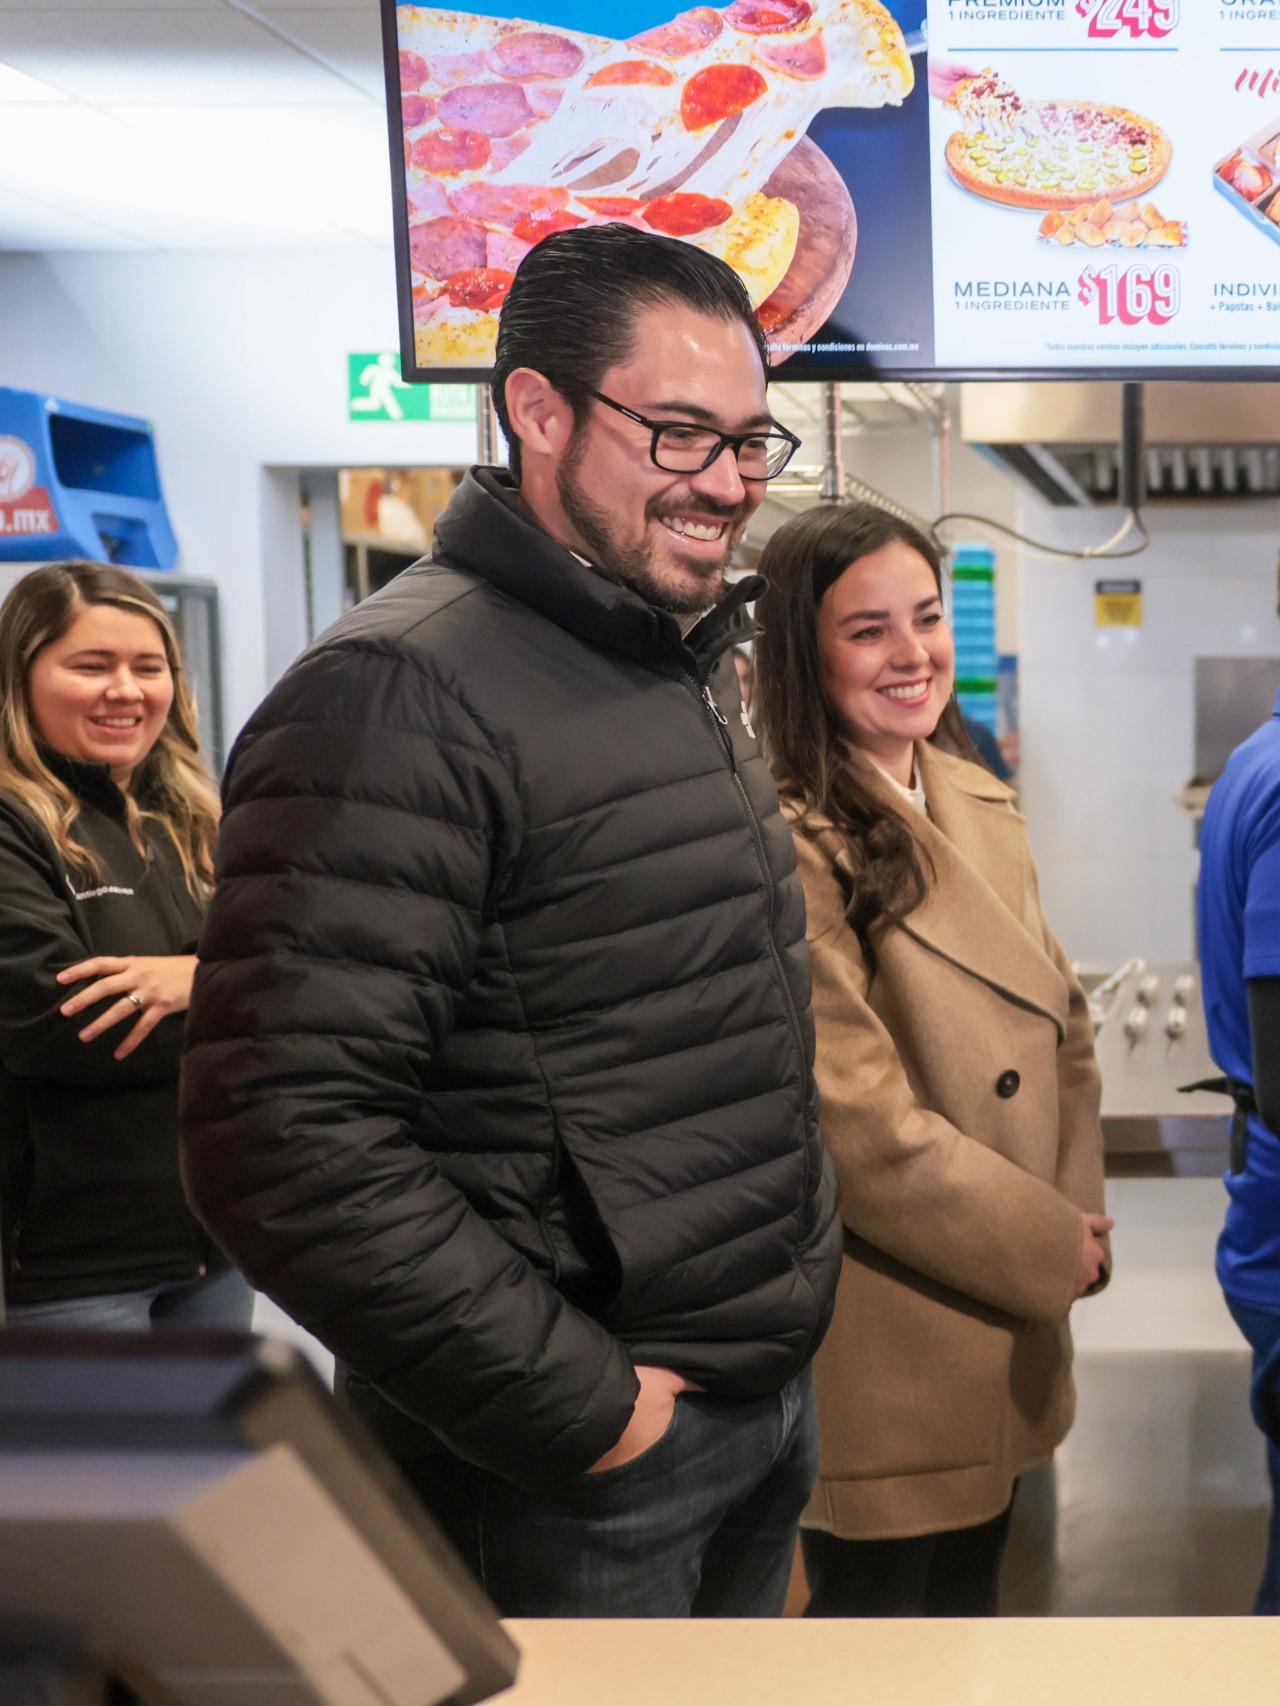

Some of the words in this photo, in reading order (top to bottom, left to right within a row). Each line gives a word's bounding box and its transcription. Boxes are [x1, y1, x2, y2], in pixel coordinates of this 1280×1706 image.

[949, 10, 954, 20] 1
[959, 10, 1065, 20] INGREDIENTE
[1219, 10, 1224, 20] 1
[954, 281, 1071, 297] MEDIANA
[1077, 264, 1181, 325] $169
[954, 300, 960, 311] 1
[965, 300, 1070, 311] INGREDIENTE
[1219, 301, 1254, 313] Papotas
